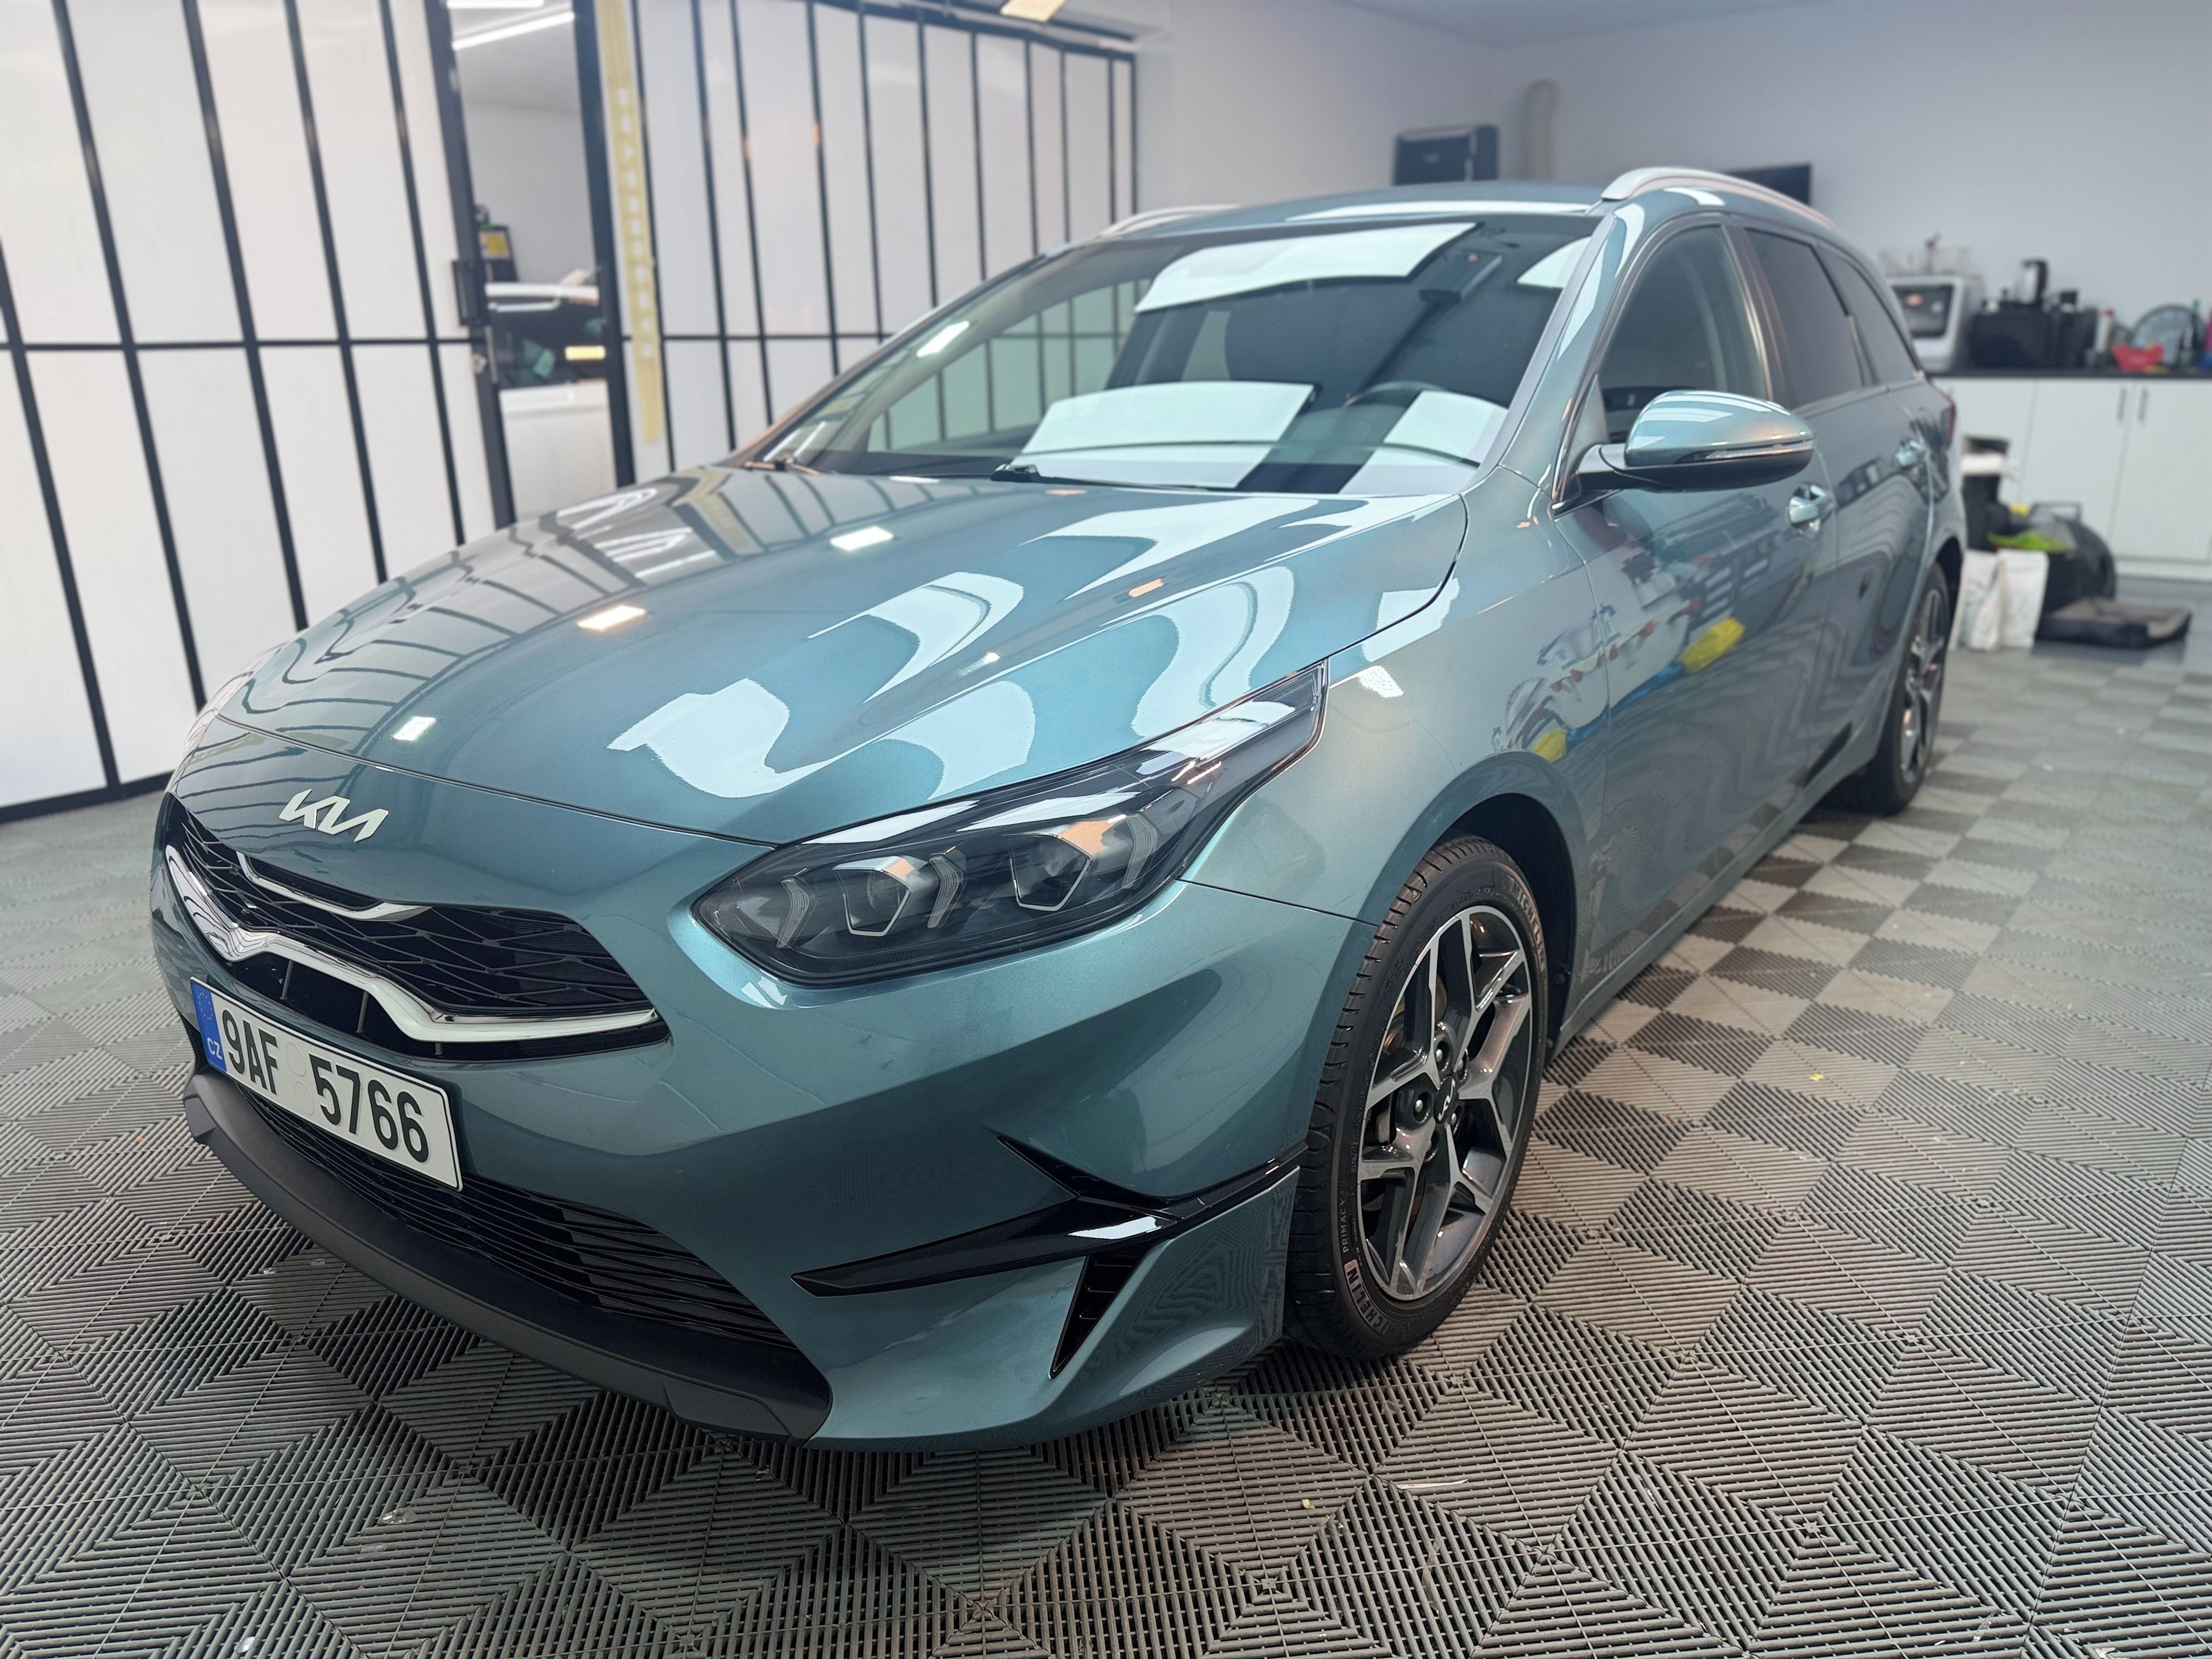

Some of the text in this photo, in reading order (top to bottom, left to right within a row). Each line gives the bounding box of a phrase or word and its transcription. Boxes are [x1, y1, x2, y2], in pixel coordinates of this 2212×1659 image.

[279, 788, 390, 843] KIA
[207, 1036, 223, 1060] CZ
[222, 1009, 430, 1164] 9AF 5766
[1339, 1197, 1350, 1254] PRIMACY
[1347, 1267, 1404, 1336] MICHELIN
